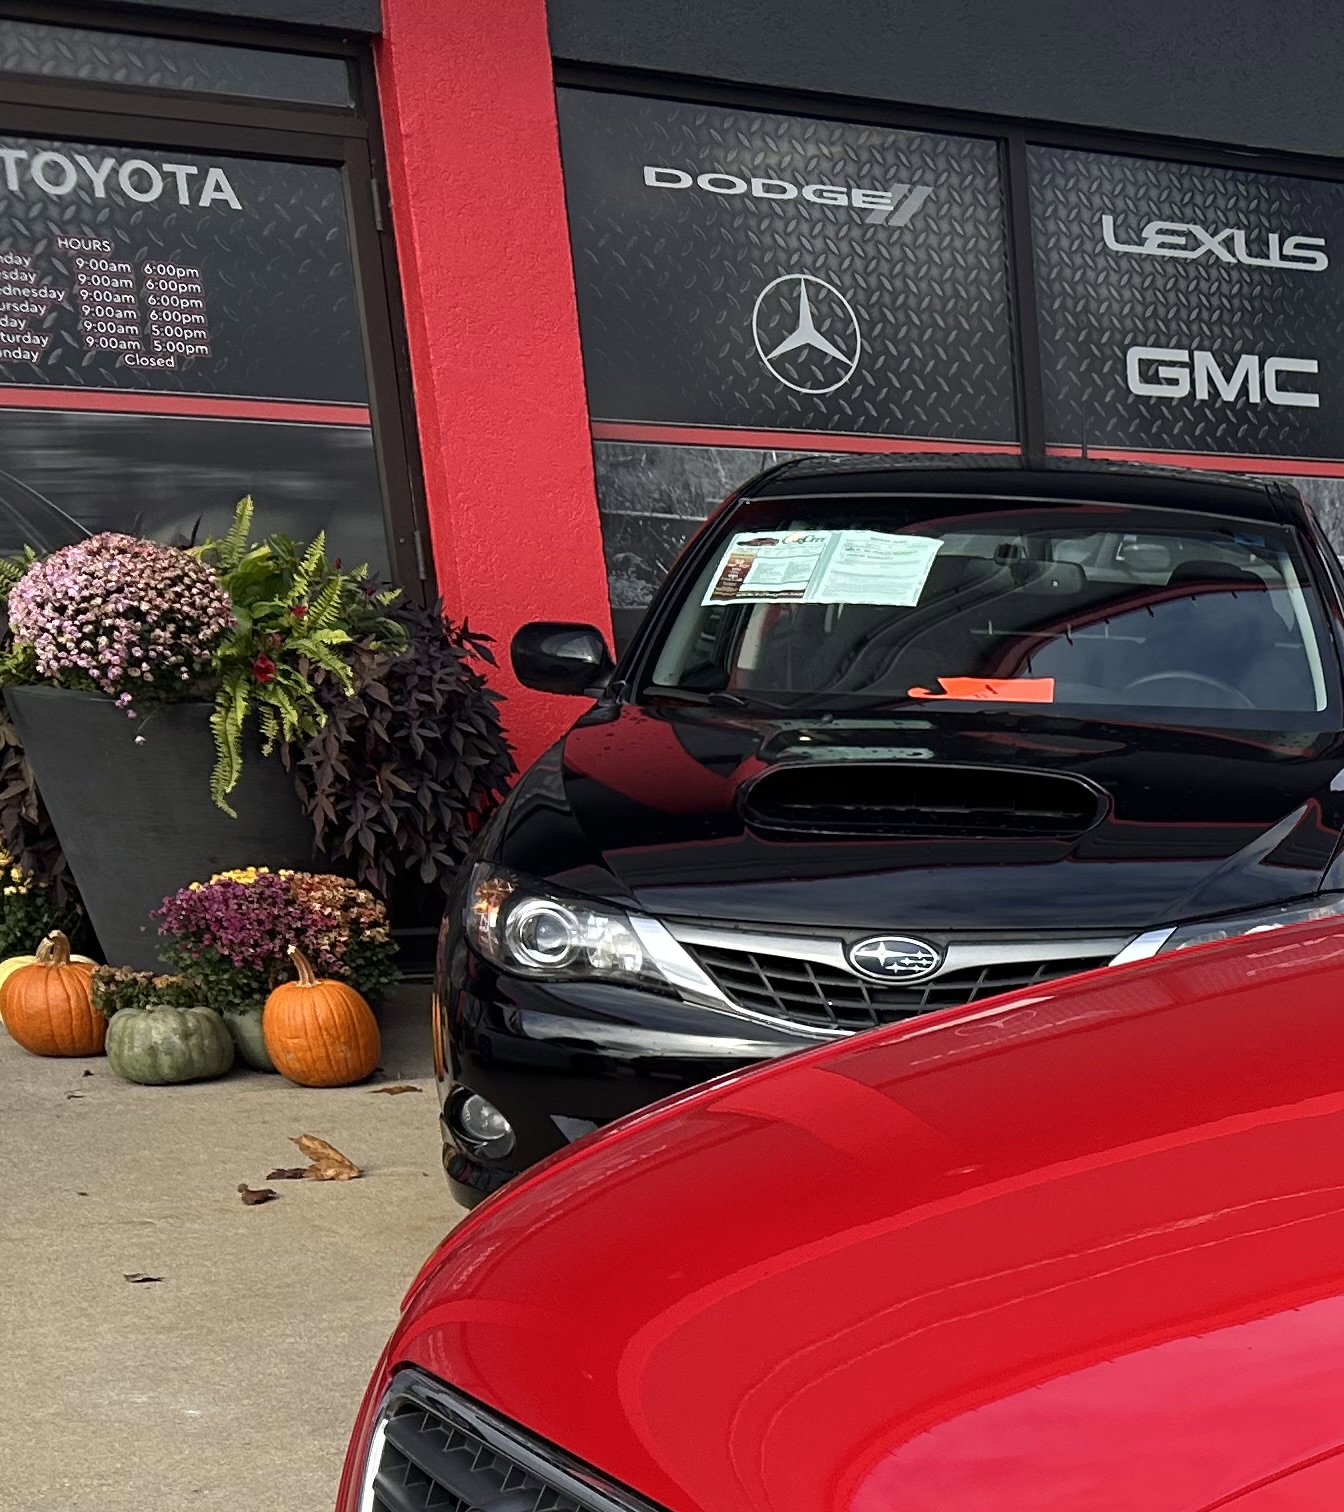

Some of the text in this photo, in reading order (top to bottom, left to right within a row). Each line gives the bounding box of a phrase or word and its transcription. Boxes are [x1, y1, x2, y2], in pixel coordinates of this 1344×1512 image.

[0, 148, 242, 210] TOYOTA
[643, 166, 894, 211] DODGE
[57, 237, 112, 252] HOURS
[1102, 214, 1329, 272] LEXUS
[75, 257, 131, 272] 9:00am
[144, 263, 199, 280] 6:00pm
[0, 268, 201, 295] sday 9:00am 6:00pm
[0, 283, 203, 311] dnesday 9:00am 6:00pm
[81, 305, 137, 320] 9:00am
[149, 310, 205, 327] 6:00pm
[83, 320, 139, 336] 9:00am
[151, 324, 207, 342] 5:00pm
[0, 347, 175, 368] nday Closed
[85, 336, 141, 351] 9:00am
[153, 339, 209, 355] 5:00pm
[1126, 345, 1320, 408] GMC
